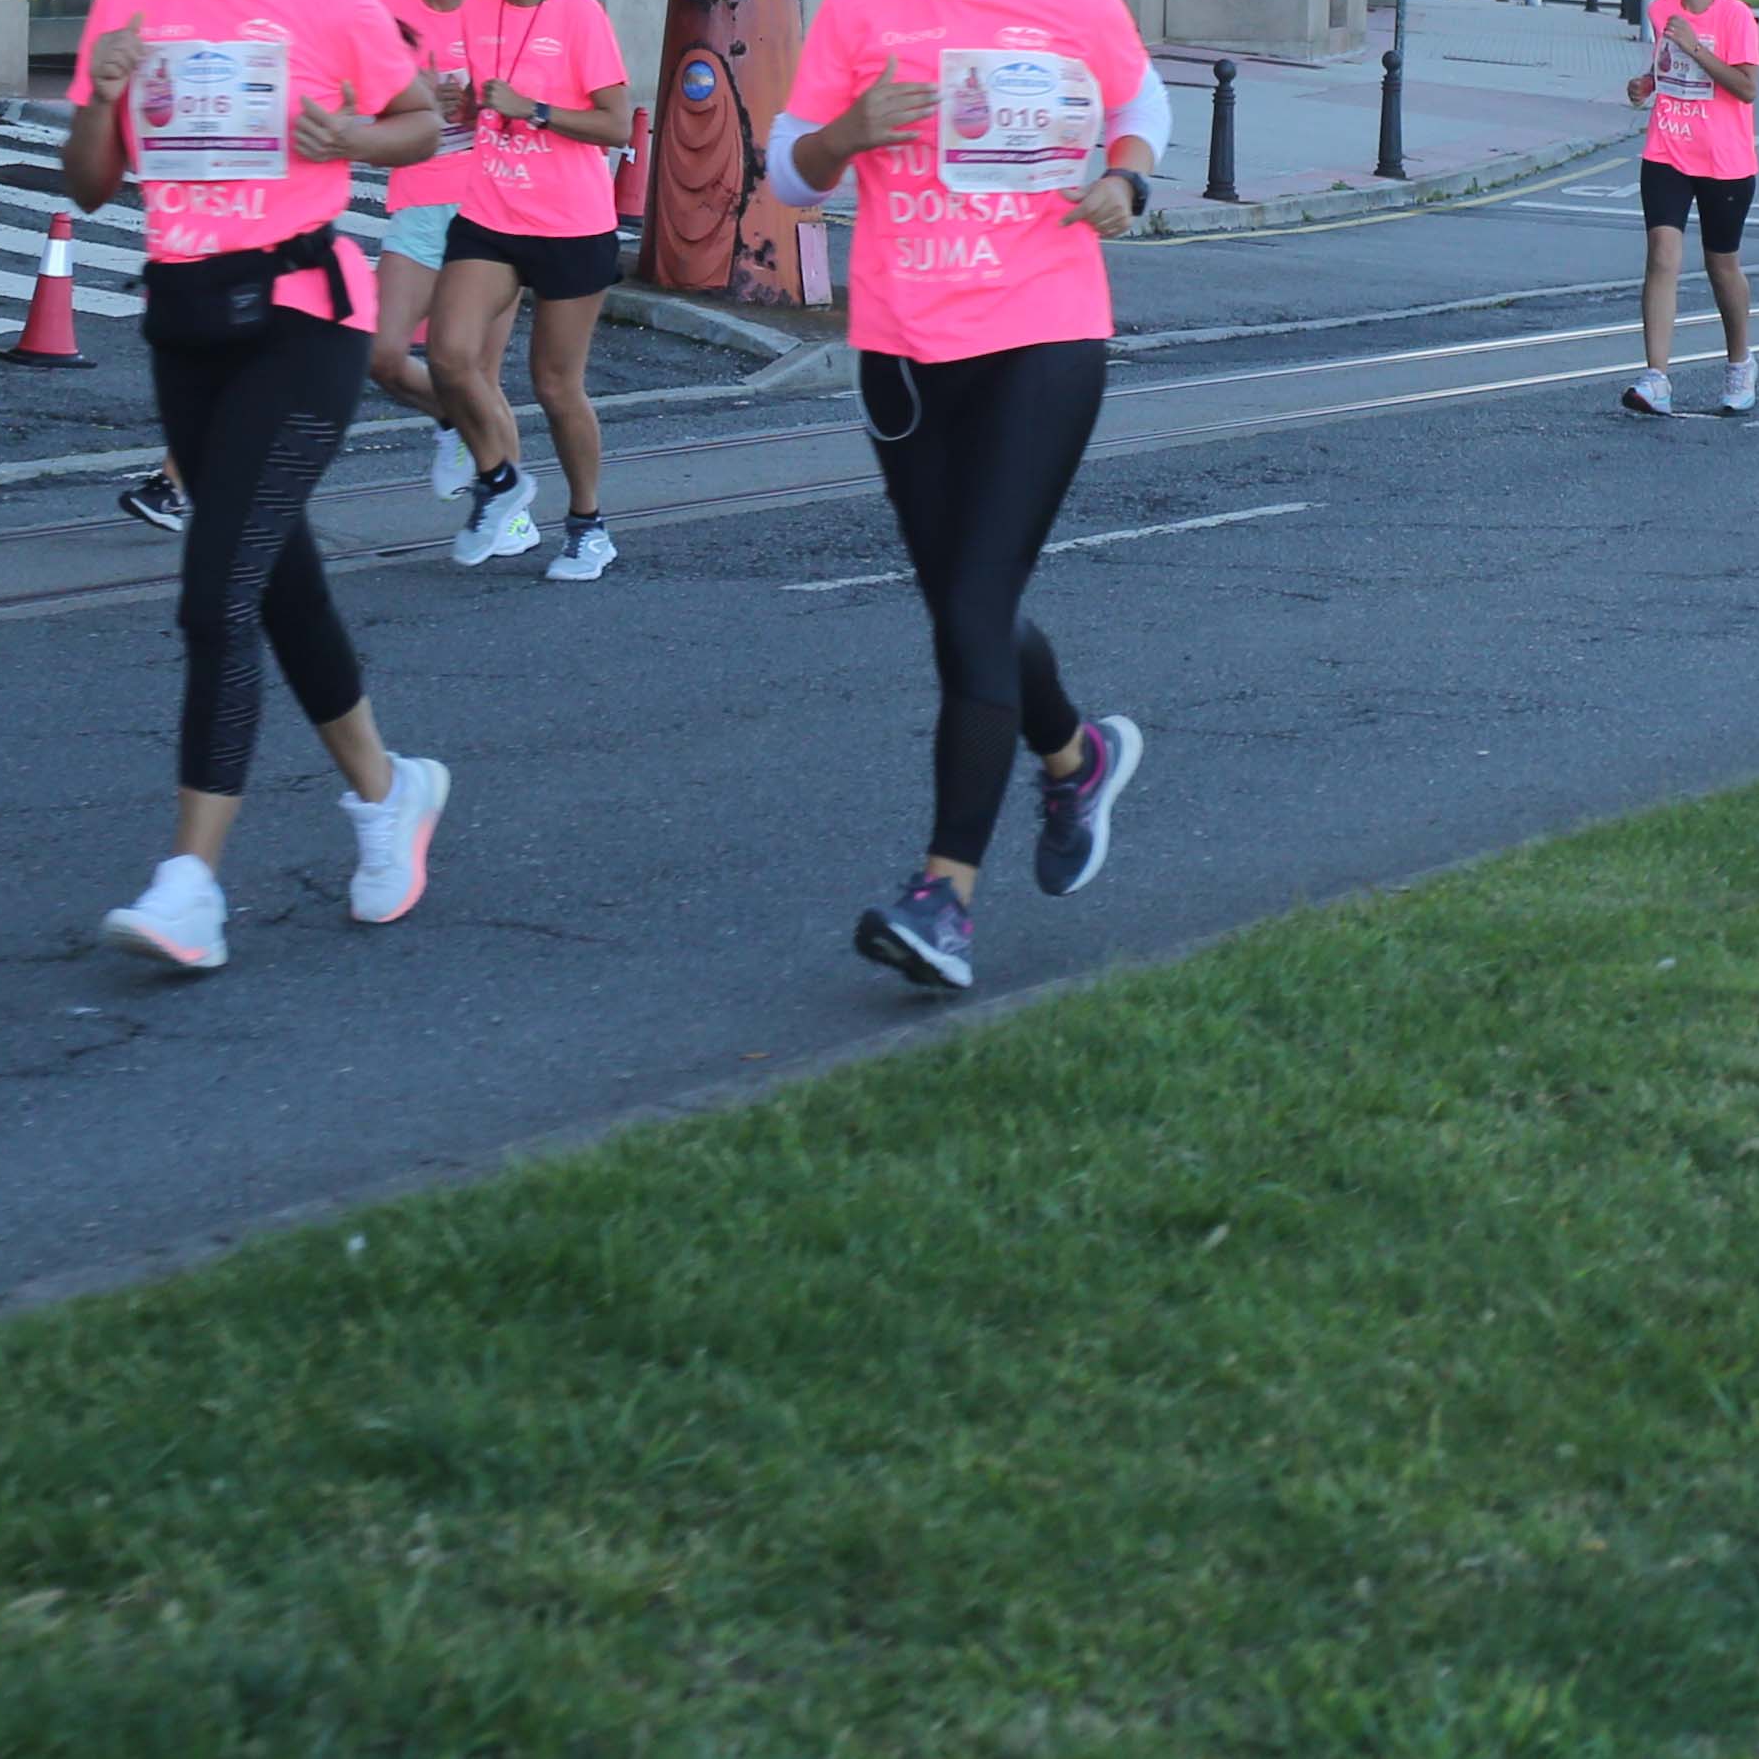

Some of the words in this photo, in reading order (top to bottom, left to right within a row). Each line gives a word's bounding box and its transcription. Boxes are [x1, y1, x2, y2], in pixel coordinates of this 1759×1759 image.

[996, 108, 1050, 128] 016
[888, 190, 1037, 224] DORSAL
[897, 235, 1003, 271] SUMA
